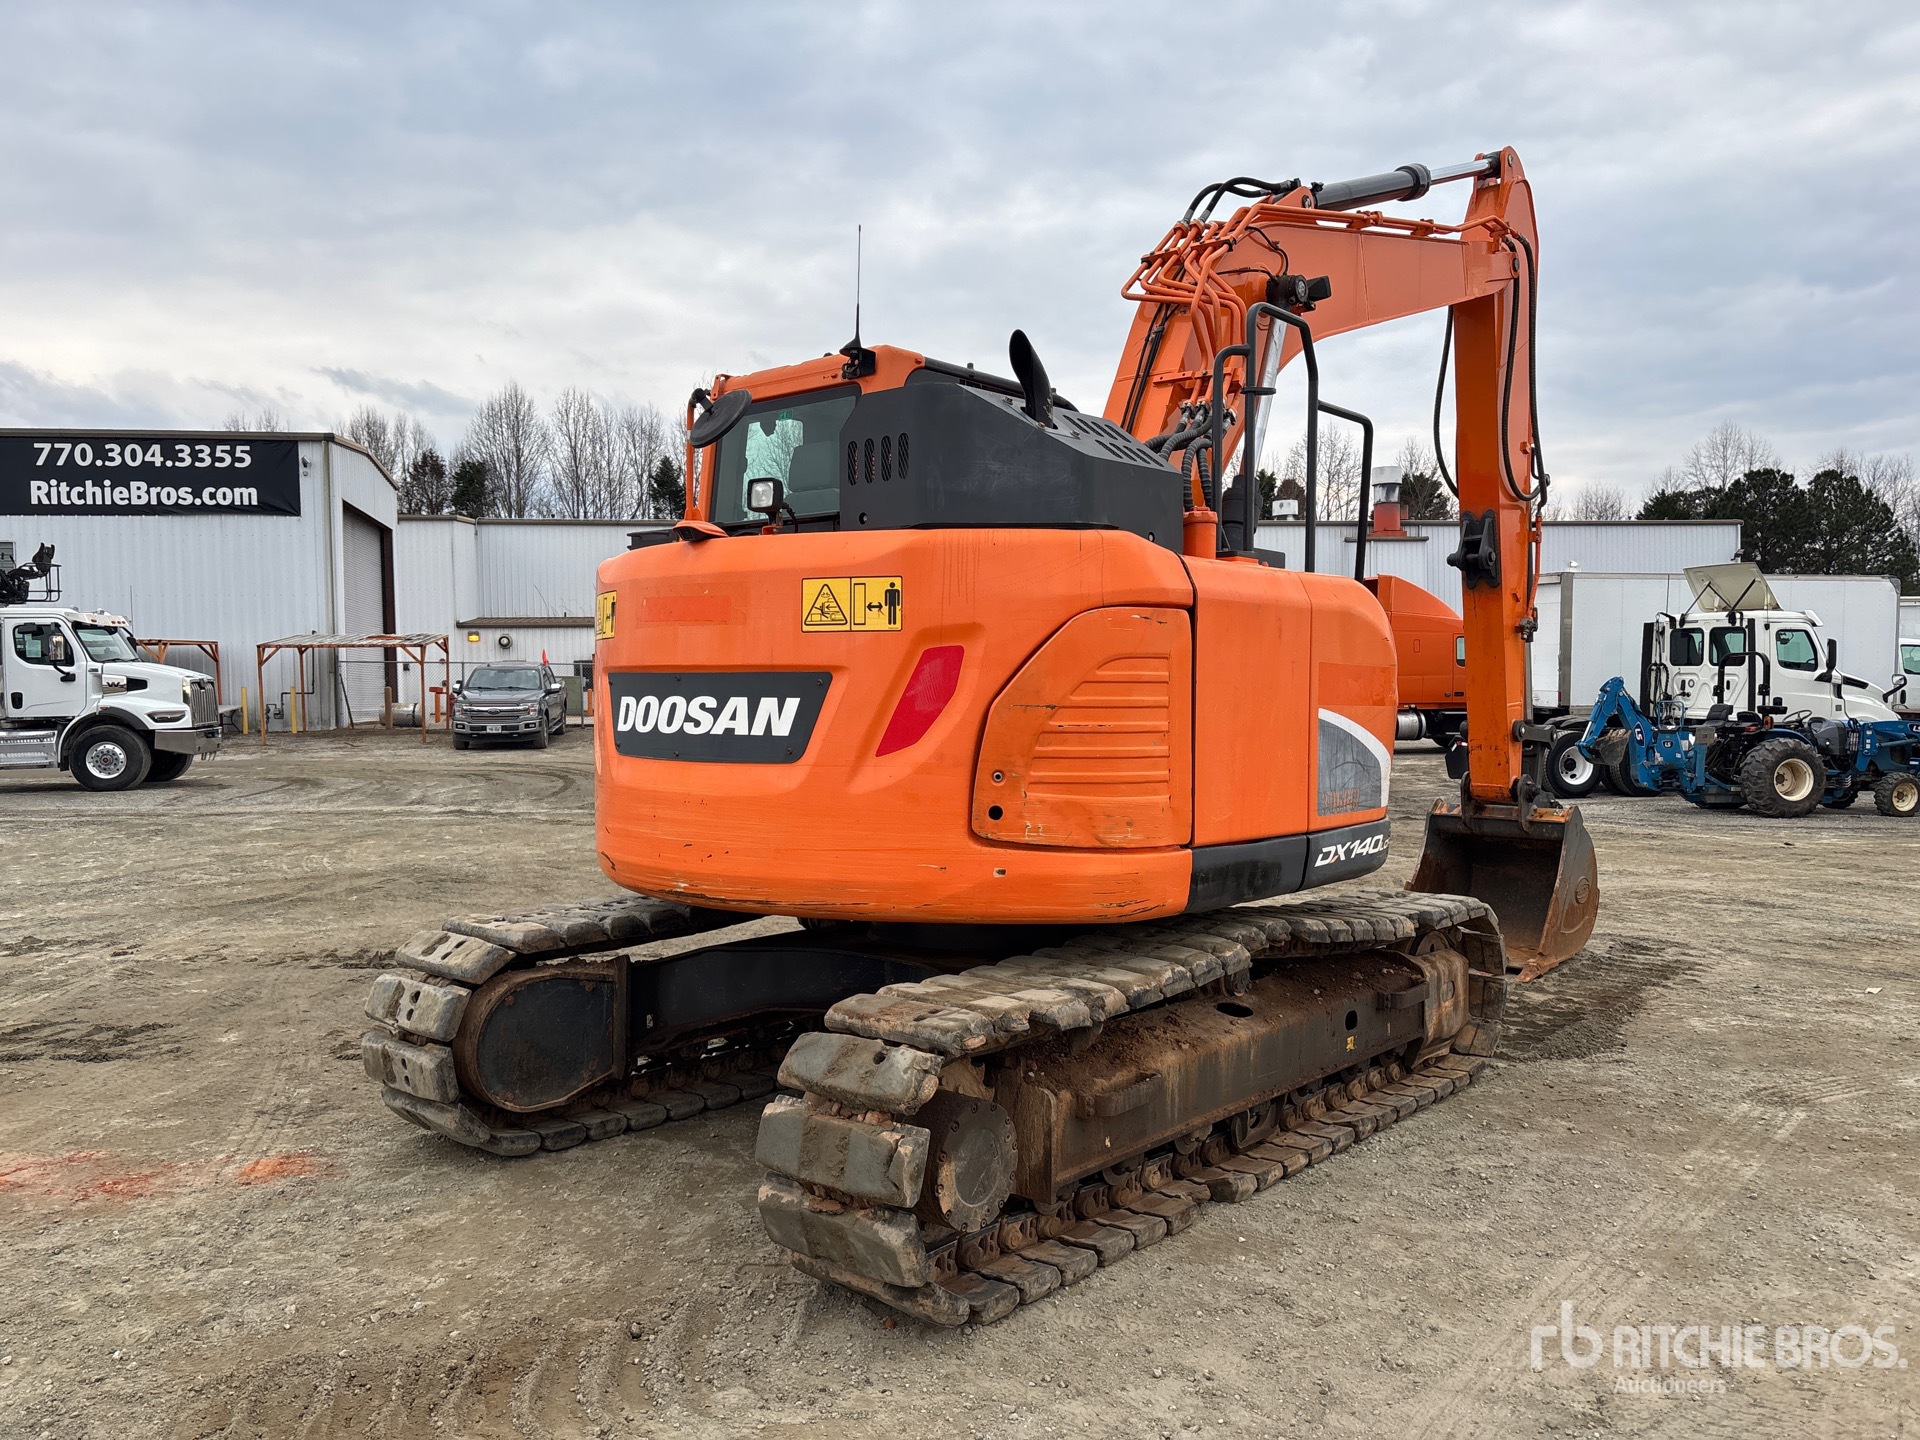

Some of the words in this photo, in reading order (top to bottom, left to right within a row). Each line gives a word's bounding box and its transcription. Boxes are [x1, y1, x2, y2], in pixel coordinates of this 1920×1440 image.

[33, 443, 252, 468] 770.304.3355
[30, 479, 258, 505] RitchieBros.com
[617, 696, 801, 736] DOOSAN
